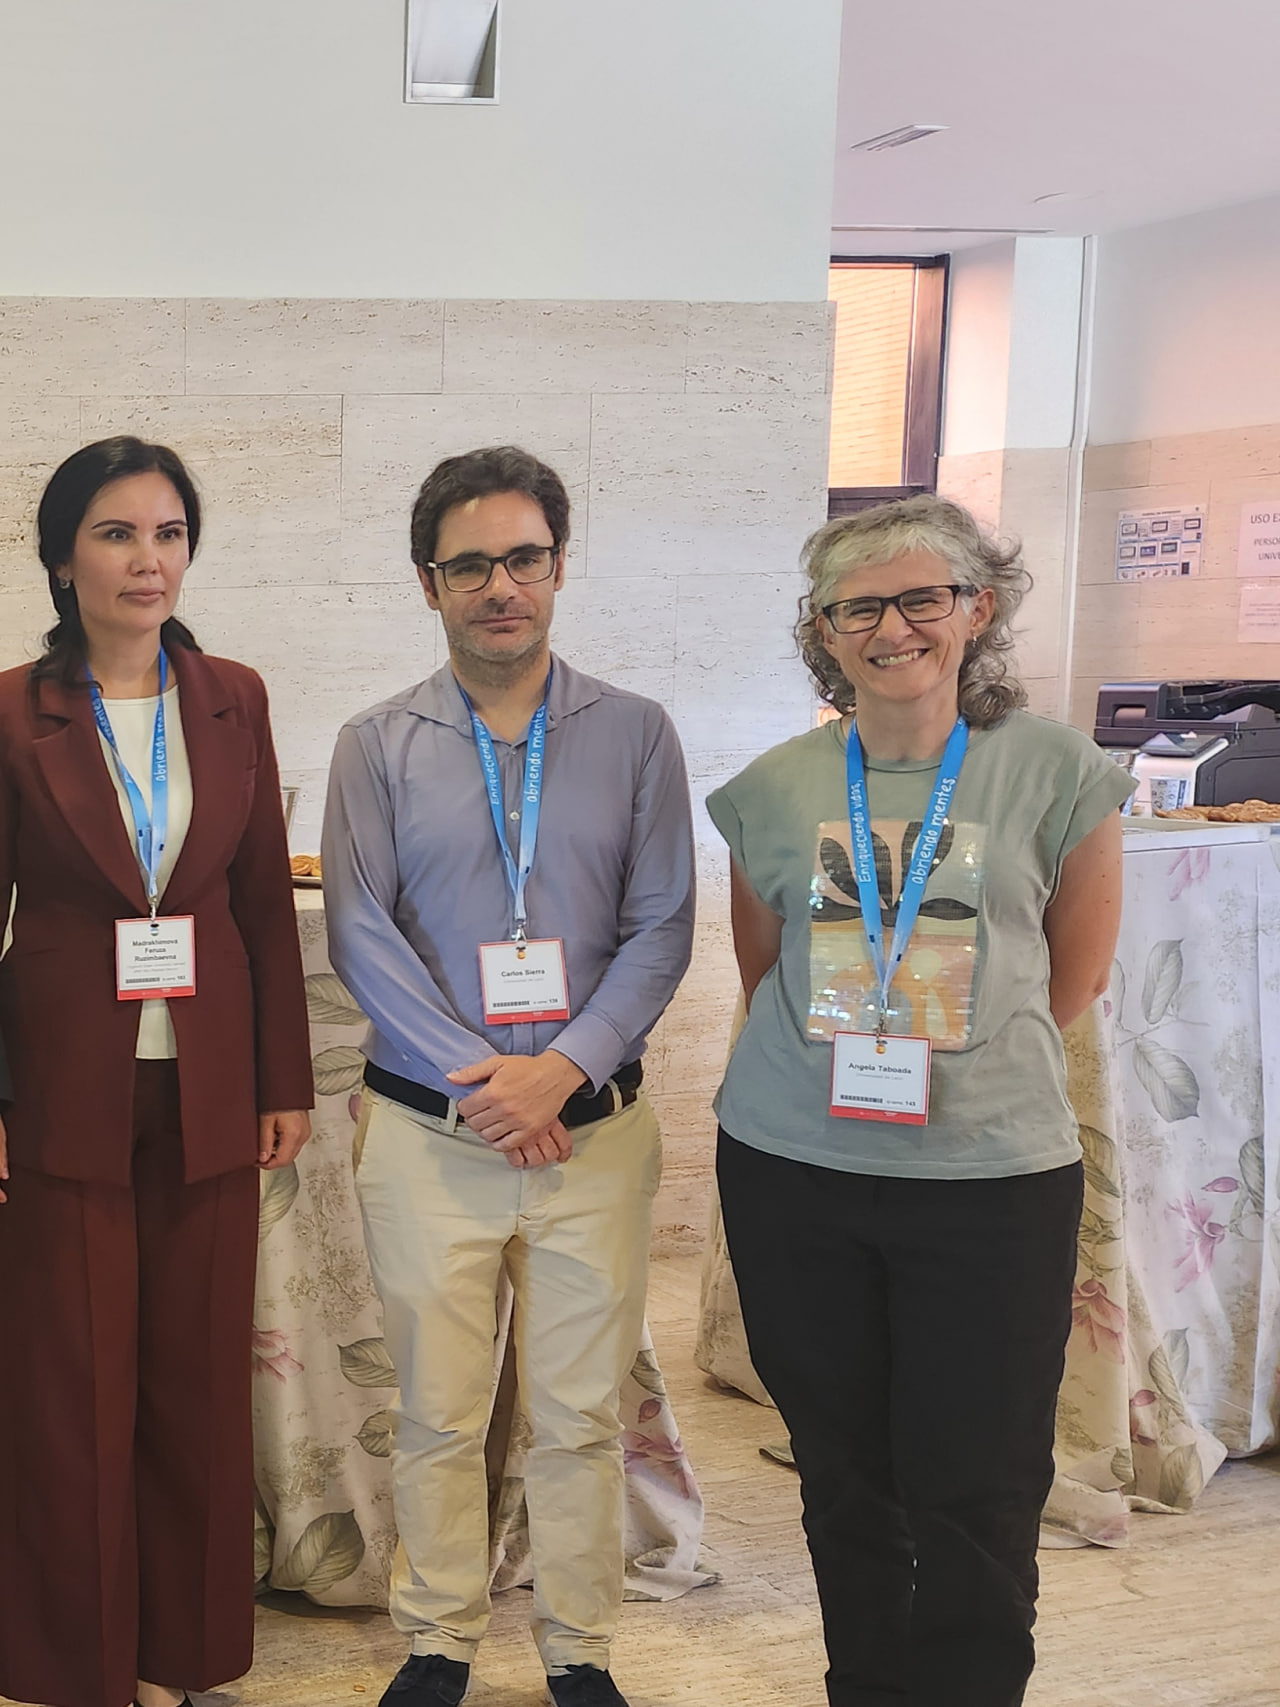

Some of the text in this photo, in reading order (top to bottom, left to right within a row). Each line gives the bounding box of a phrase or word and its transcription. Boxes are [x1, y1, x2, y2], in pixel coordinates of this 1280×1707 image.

[1250, 513, 1271, 525] USO
[523, 752, 541, 804] abriendo
[852, 812, 873, 883] Enriqueciendo
[911, 829, 938, 885] abriendo
[848, 1062, 912, 1075] Angela Taboada
